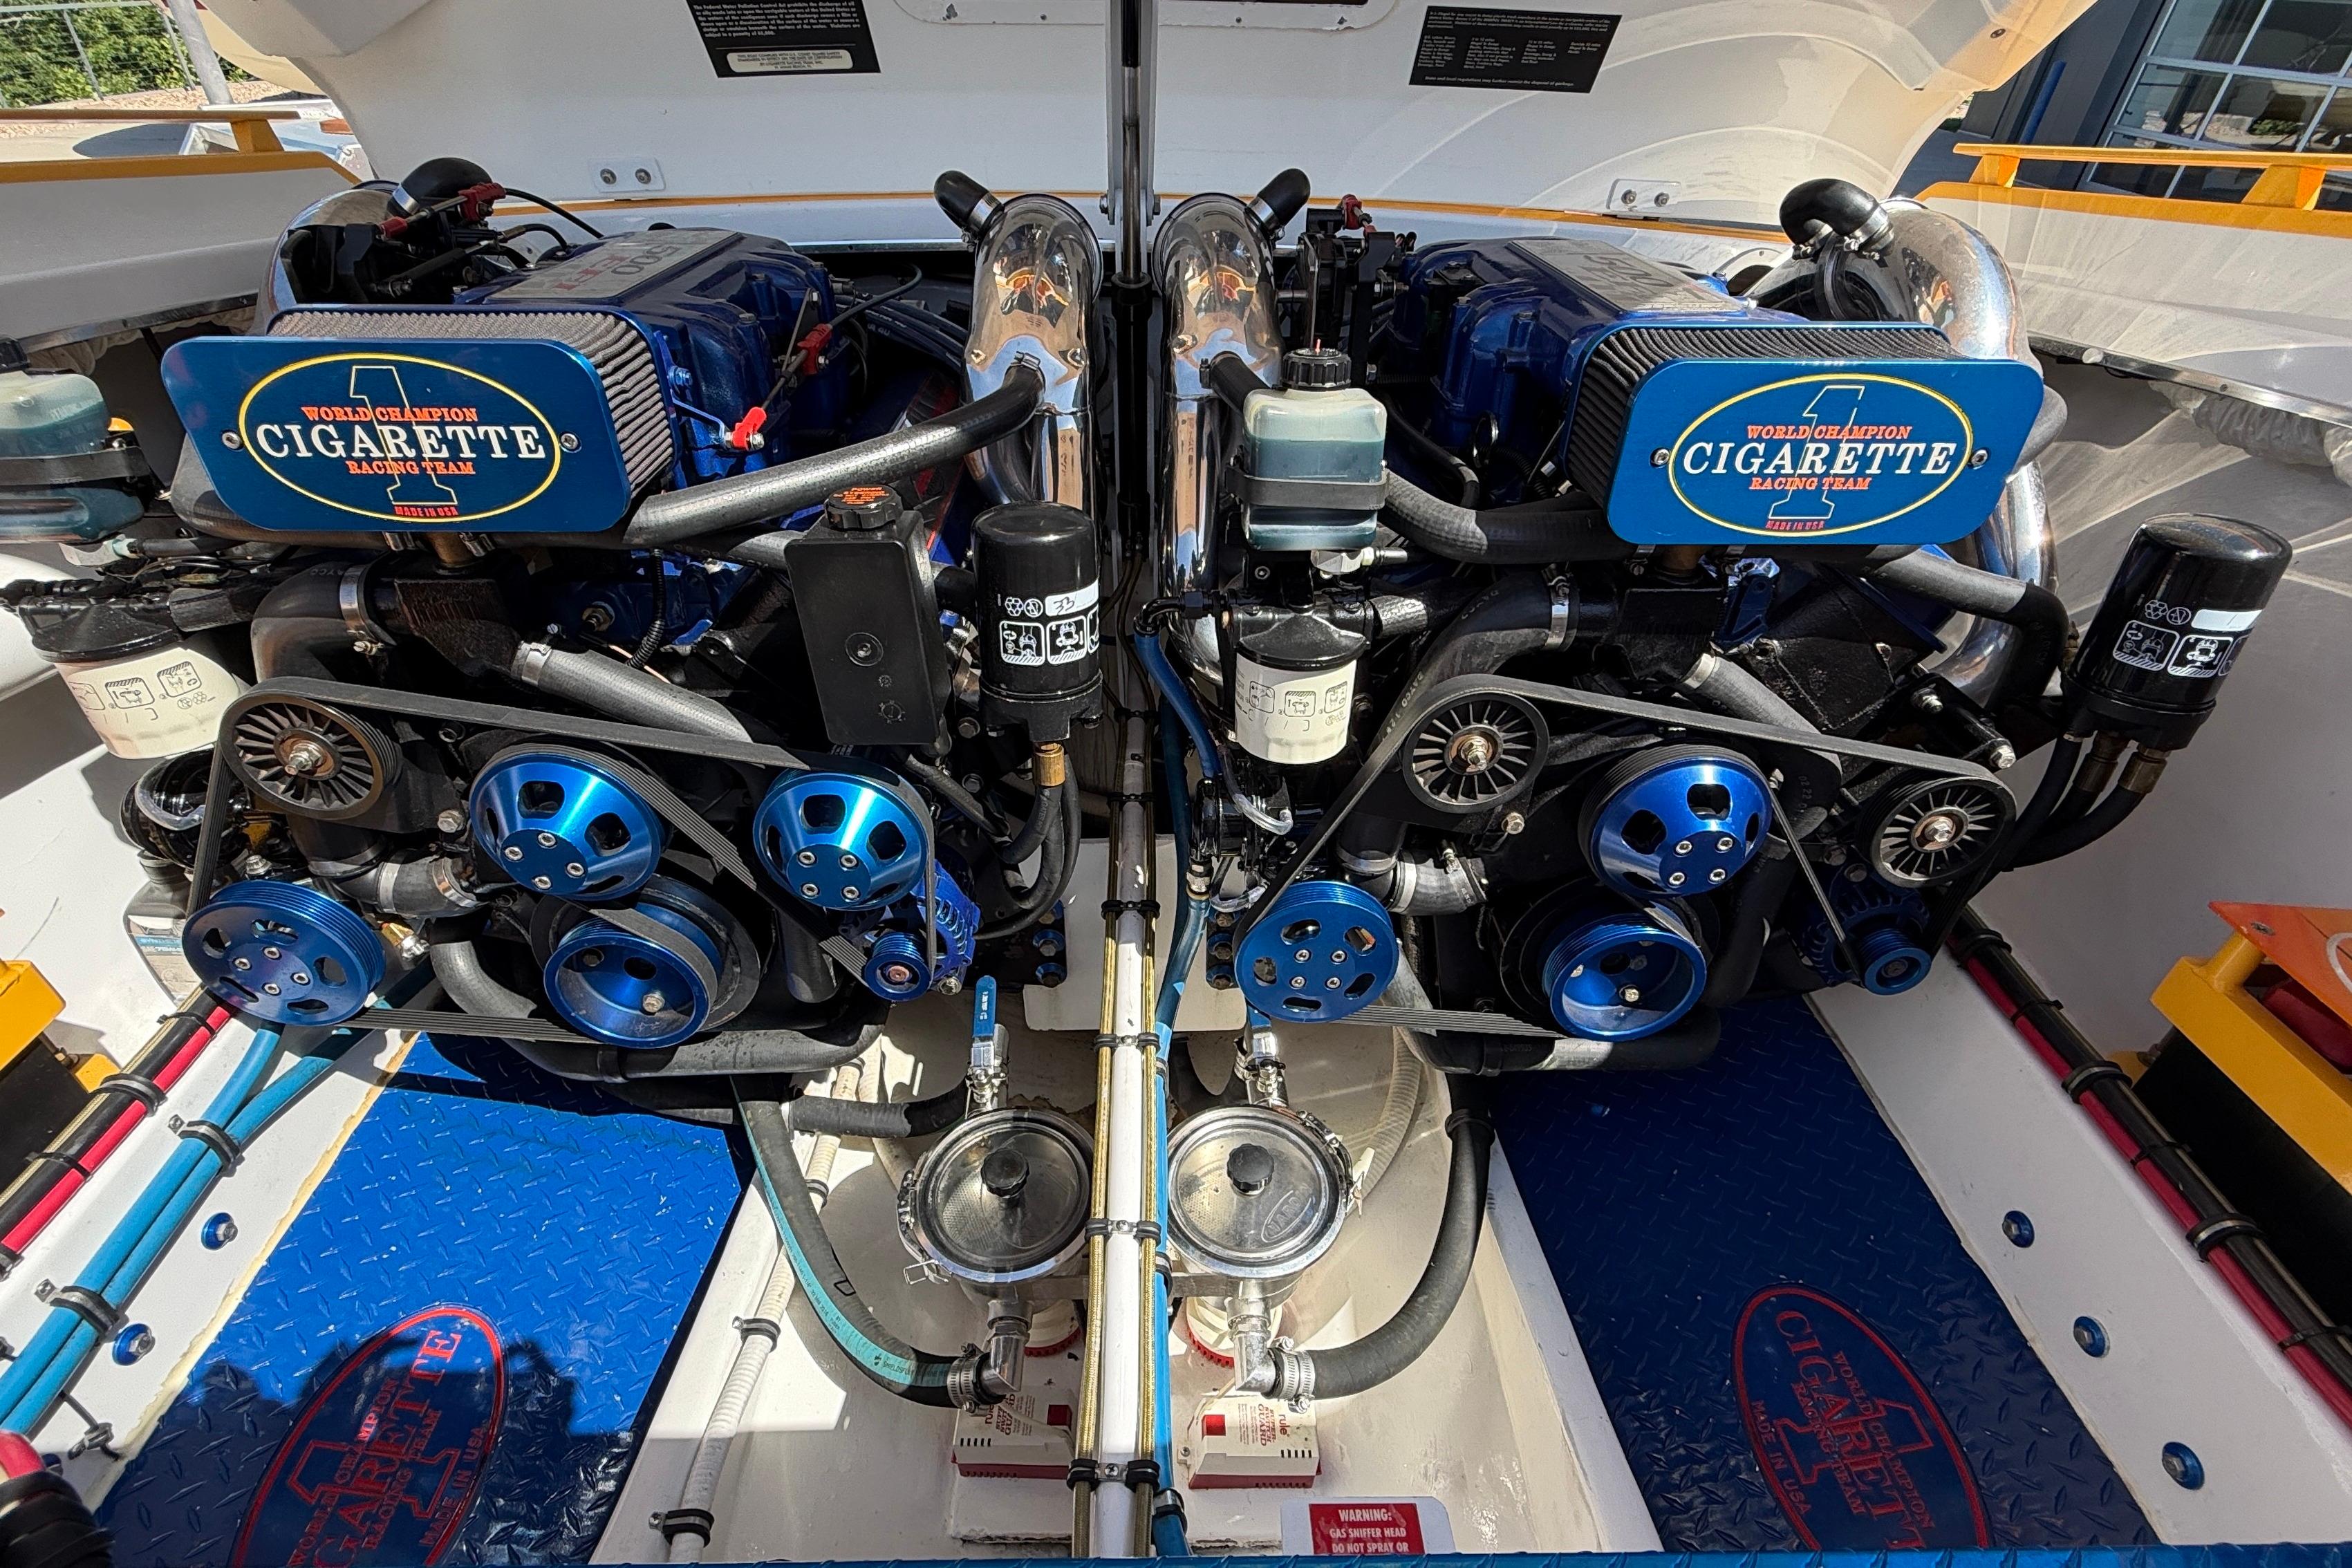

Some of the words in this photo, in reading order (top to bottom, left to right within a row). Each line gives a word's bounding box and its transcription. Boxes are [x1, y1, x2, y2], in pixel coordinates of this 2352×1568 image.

[301, 407, 372, 422] WORLD
[377, 407, 478, 422] CHAMPION
[256, 424, 546, 460] CIGARETTE
[1747, 425, 1809, 440] WORLD
[1813, 425, 1912, 440] CHAMPION
[345, 461, 420, 474] RACING
[422, 461, 476, 474] TEAM
[1683, 442, 1957, 476] CIGARETTE
[1749, 478, 1818, 490] RACING
[1822, 478, 1872, 490] TEAM
[395, 506, 419, 516] MADE
[420, 507, 433, 516] IN
[436, 506, 459, 516] USA
[1765, 520, 1791, 530] MADE
[1792, 521, 1805, 530] IN
[1806, 520, 1825, 530] USA
[1258, 1403, 1267, 1446] GUARD
[1278, 1415, 1290, 1435] rule
[1775, 1310, 1926, 1549] CIGARETT
[462, 1426, 486, 1464] USA
[1791, 1383, 1832, 1454] RACING
[1831, 1459, 1866, 1515] TEAM
[1833, 1350, 1873, 1416] WORLD
[1869, 1419, 1935, 1529] CHAMPION
[1751, 1400, 1776, 1444] MADE
[1769, 1453, 1786, 1471] IN
[1782, 1479, 1812, 1515] USA
[286, 1489, 339, 1567] WORLD
[335, 1378, 399, 1485] CHAMPION
[362, 1467, 413, 1550] RACING
[409, 1408, 443, 1459] TEAM
[452, 1470, 474, 1490] IN
[419, 1496, 459, 1547] MADE
[1338, 1508, 1392, 1522] WARNING:
[1329, 1528, 1347, 1539] GAS
[1348, 1528, 1382, 1539] SNIFFER
[1384, 1527, 1407, 1538] HEAD
[1332, 1543, 1345, 1553] DO
[1347, 1543, 1365, 1553] NOT
[1367, 1542, 1394, 1553] SPRAY
[1396, 1542, 1410, 1553] OR
